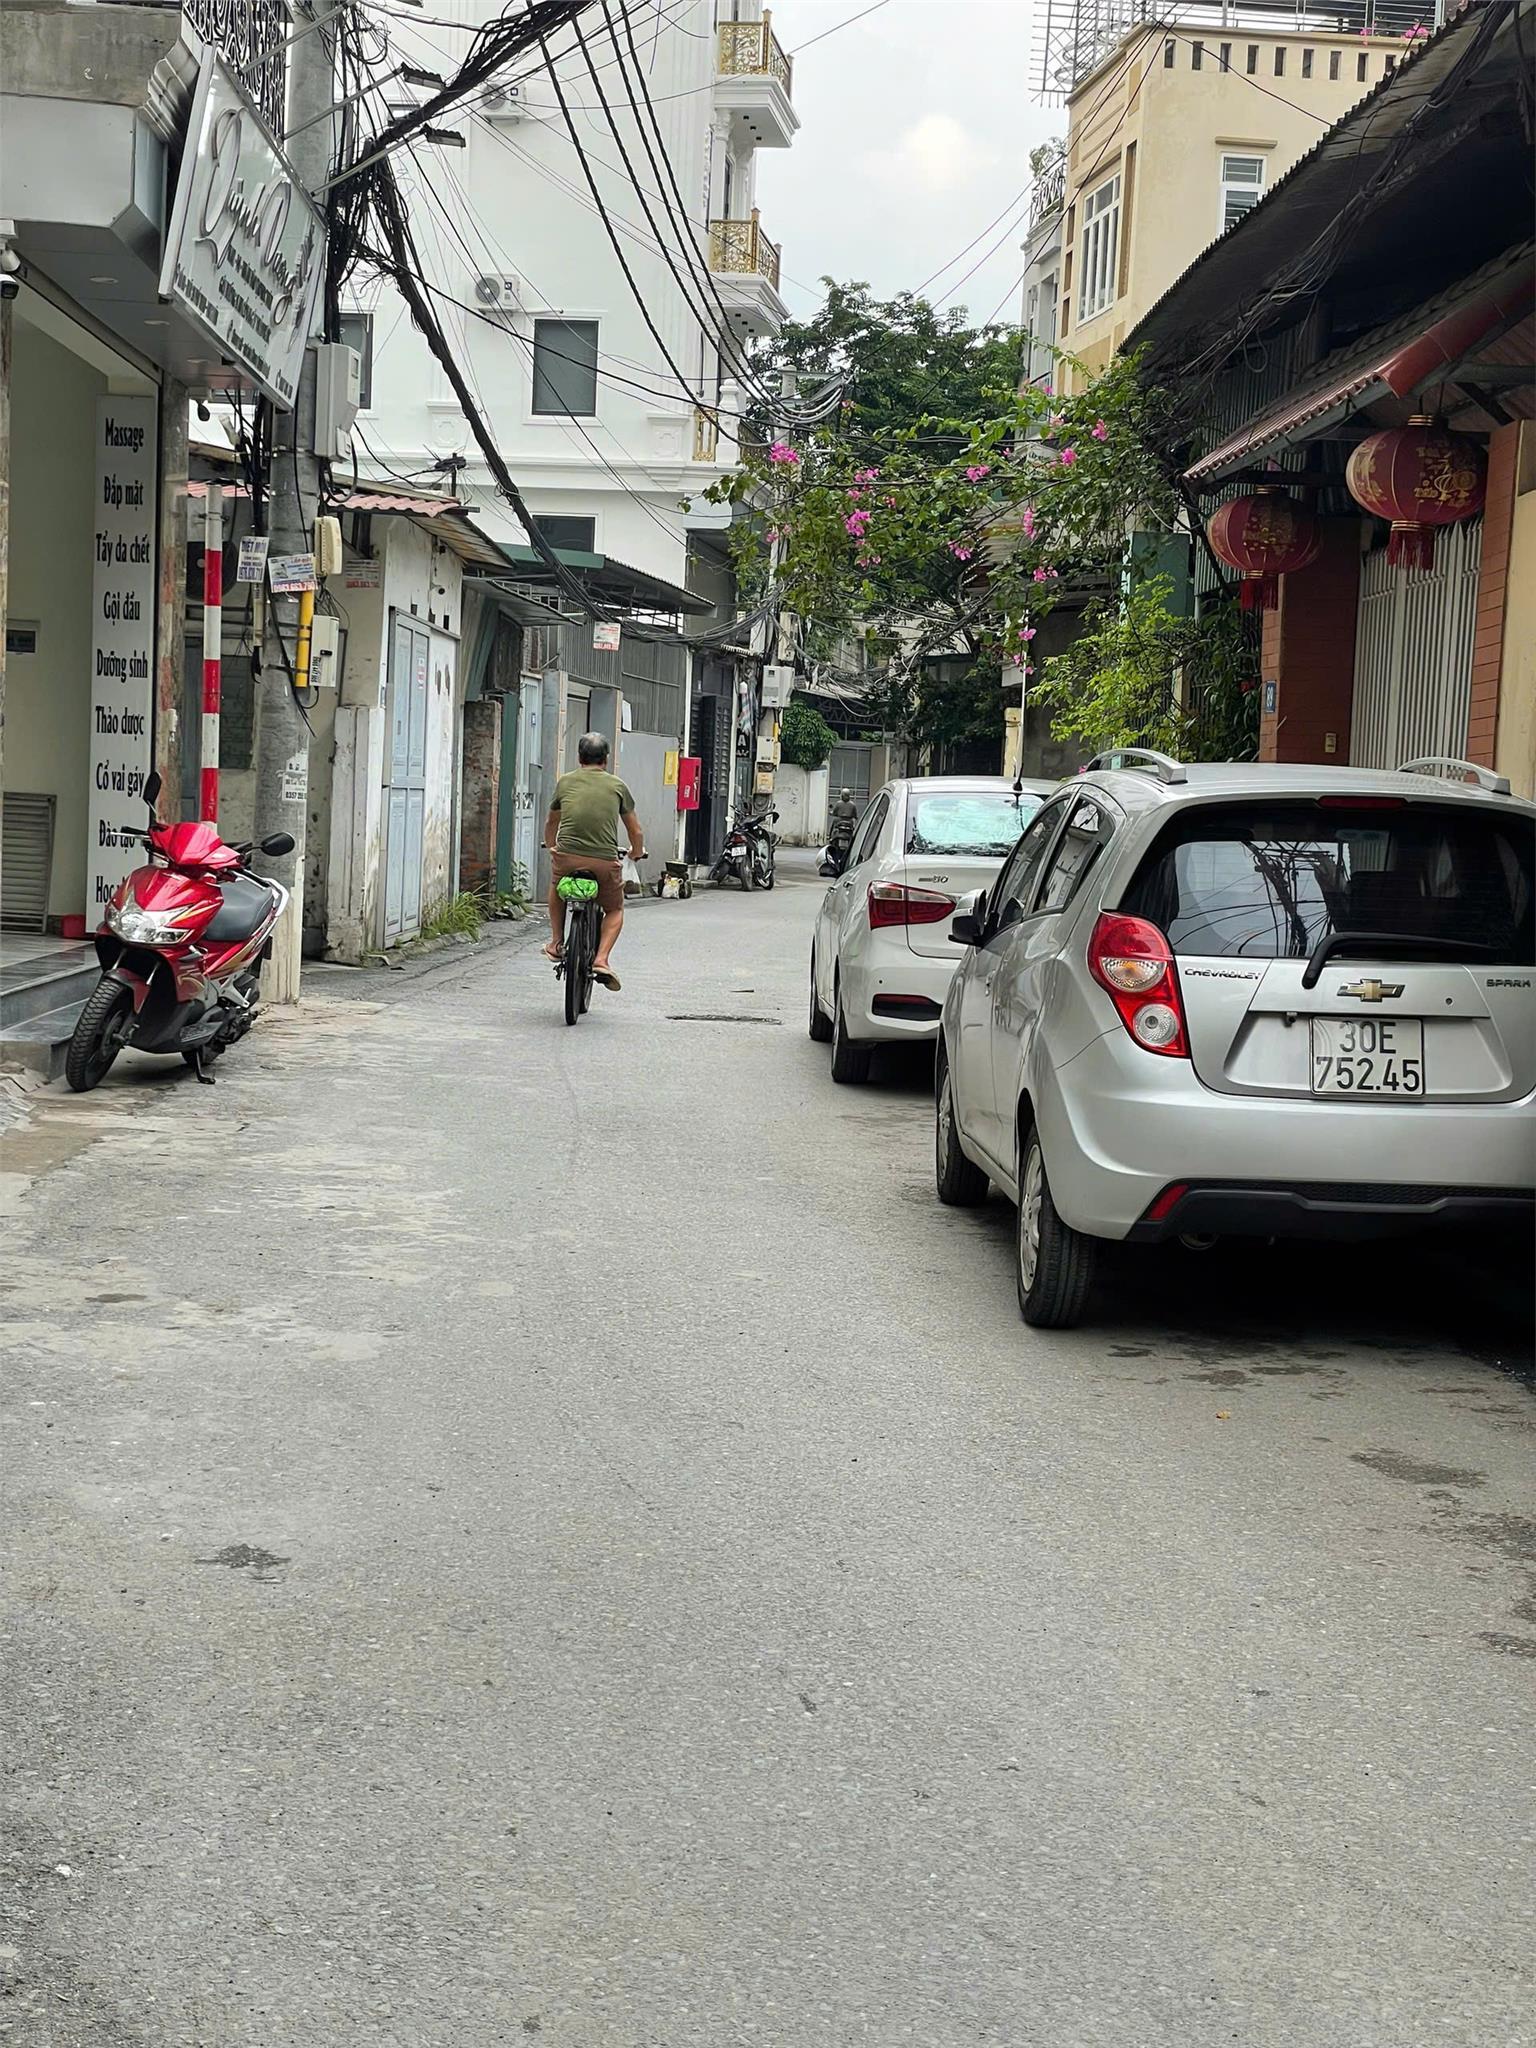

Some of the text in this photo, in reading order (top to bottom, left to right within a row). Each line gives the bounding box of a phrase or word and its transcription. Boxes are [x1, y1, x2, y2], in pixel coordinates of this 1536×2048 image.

[105, 418, 144, 453] Massage
[96, 530, 149, 567] Tẩy da chết
[104, 591, 120, 626] Gội
[96, 648, 148, 683] Dưỡng sinh
[95, 705, 144, 741] Thảo dược
[96, 759, 144, 798] Cổ vai gáy
[99, 819, 117, 848] Đào
[1184, 967, 1261, 980] CHEVROLET
[1487, 979, 1531, 988] SPARK
[1339, 1021, 1397, 1054] 30E
[1316, 1056, 1420, 1092] 752.45
